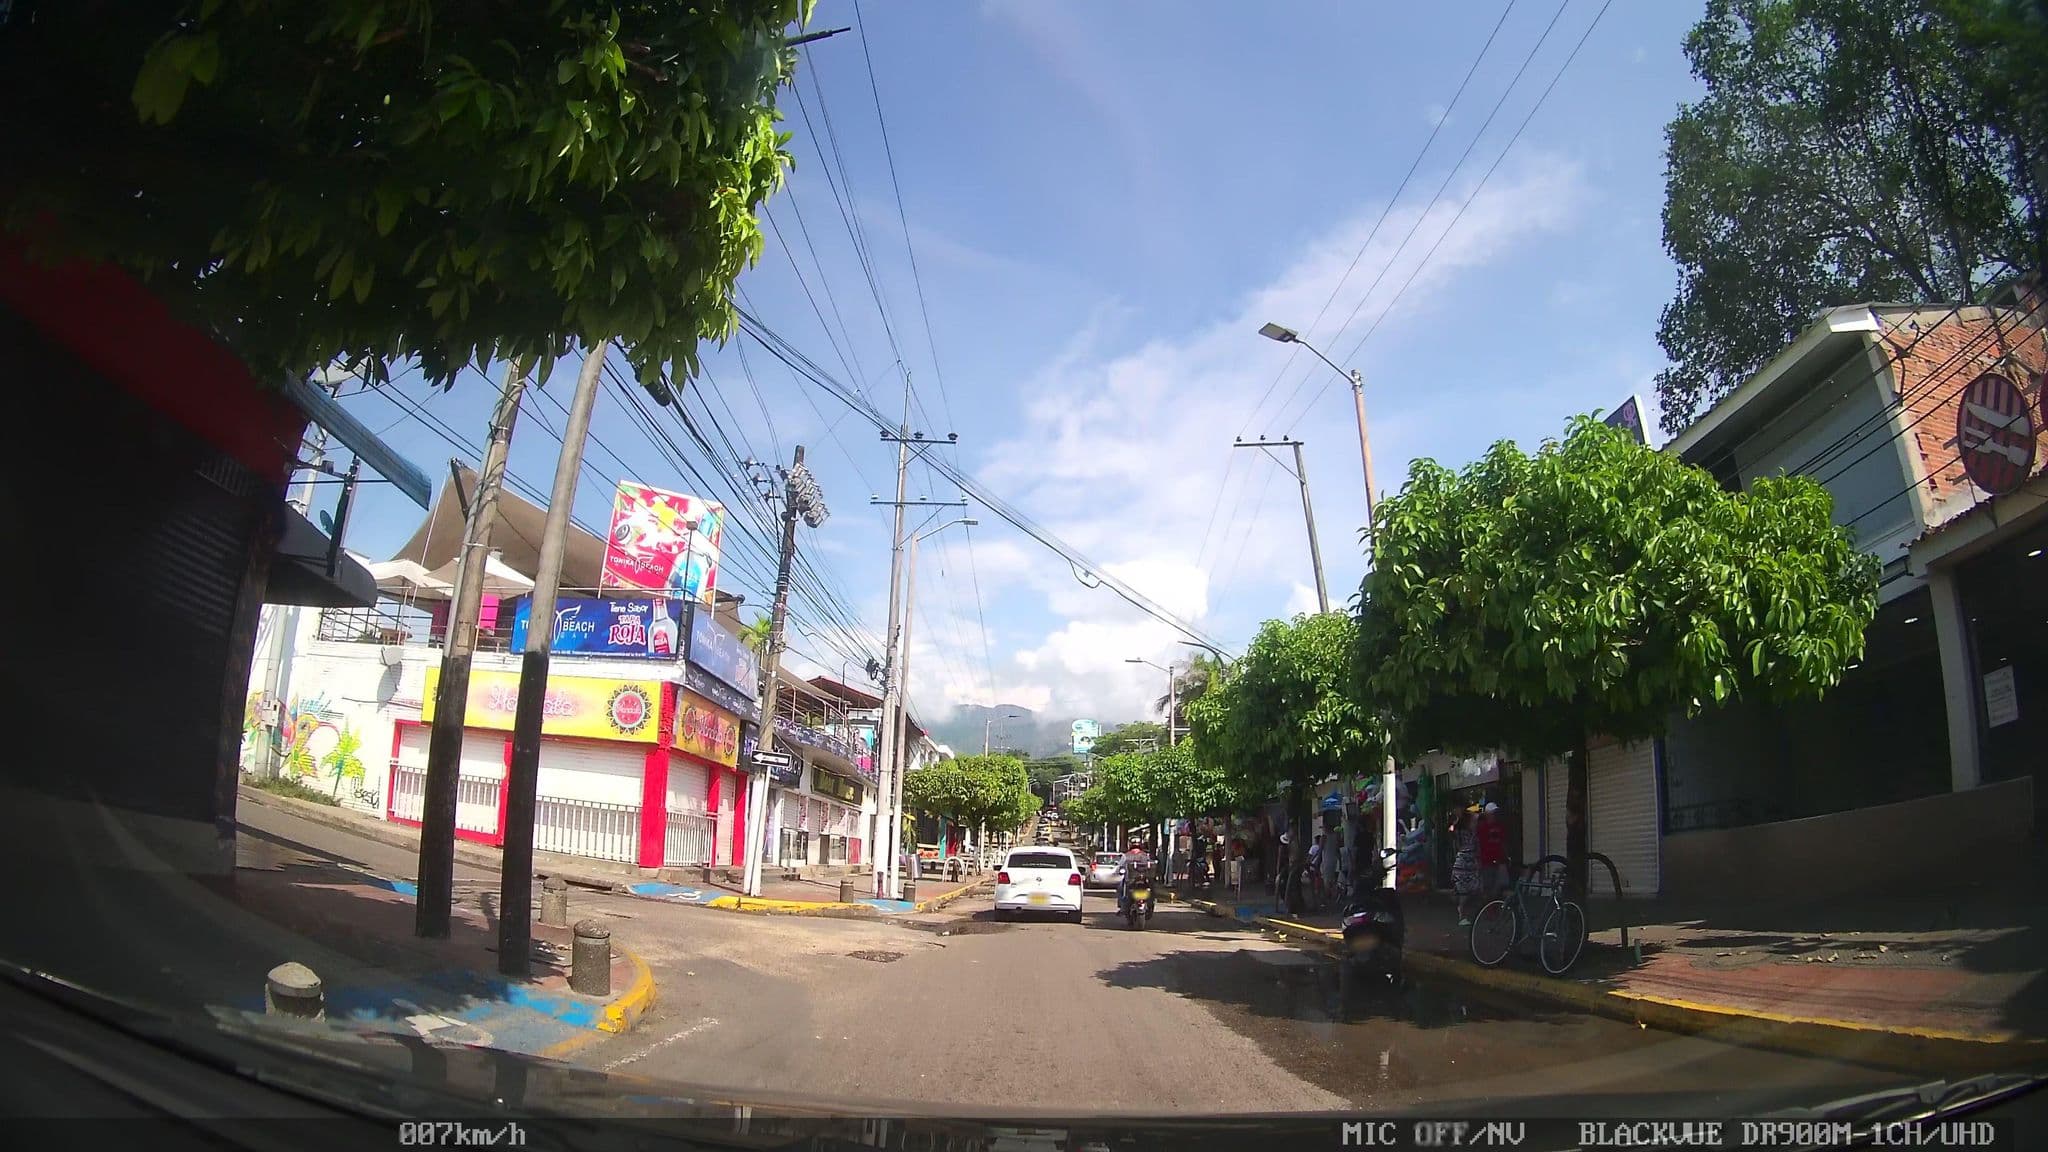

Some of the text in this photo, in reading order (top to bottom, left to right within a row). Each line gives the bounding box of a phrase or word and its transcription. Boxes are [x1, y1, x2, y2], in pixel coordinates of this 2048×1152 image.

[610, 555, 664, 573] TONIKA BEACH
[562, 620, 595, 633] BEACH
[608, 624, 646, 646] ROJA
